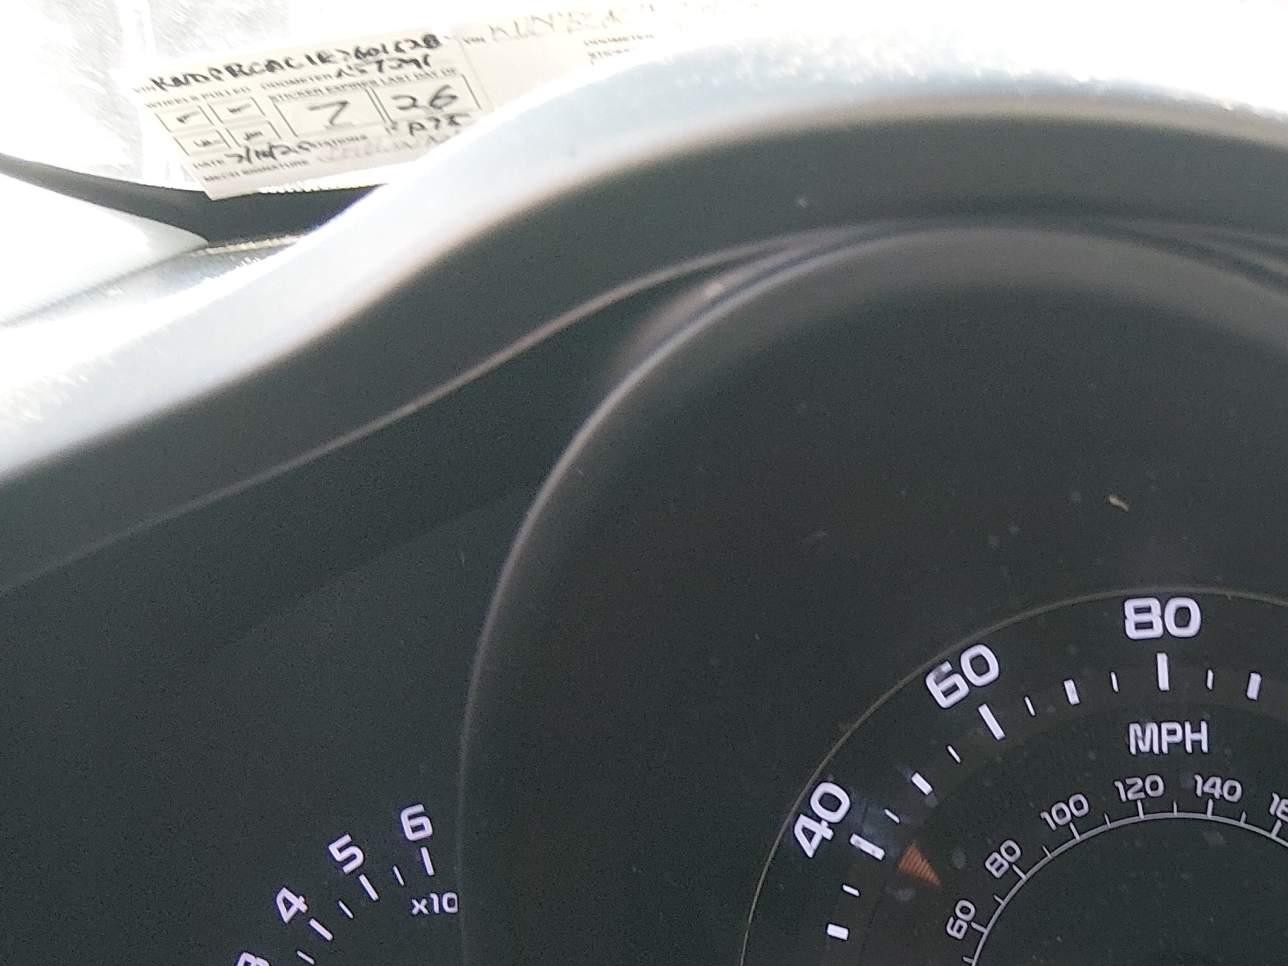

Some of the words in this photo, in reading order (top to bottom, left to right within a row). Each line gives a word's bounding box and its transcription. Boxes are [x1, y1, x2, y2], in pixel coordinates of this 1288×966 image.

[391, 84, 459, 111] 26
[1123, 596, 1203, 641] 80
[926, 643, 1001, 713] 60
[1128, 721, 1209, 756] MPH
[1114, 774, 1166, 803] 120
[1193, 773, 1243, 804] 140
[400, 804, 433, 842] 6
[793, 780, 853, 861] 40
[1040, 793, 1092, 832] 100
[328, 834, 366, 875] 5
[984, 839, 1025, 880] 80
[275, 886, 309, 924] 4
[946, 898, 979, 941] 60
